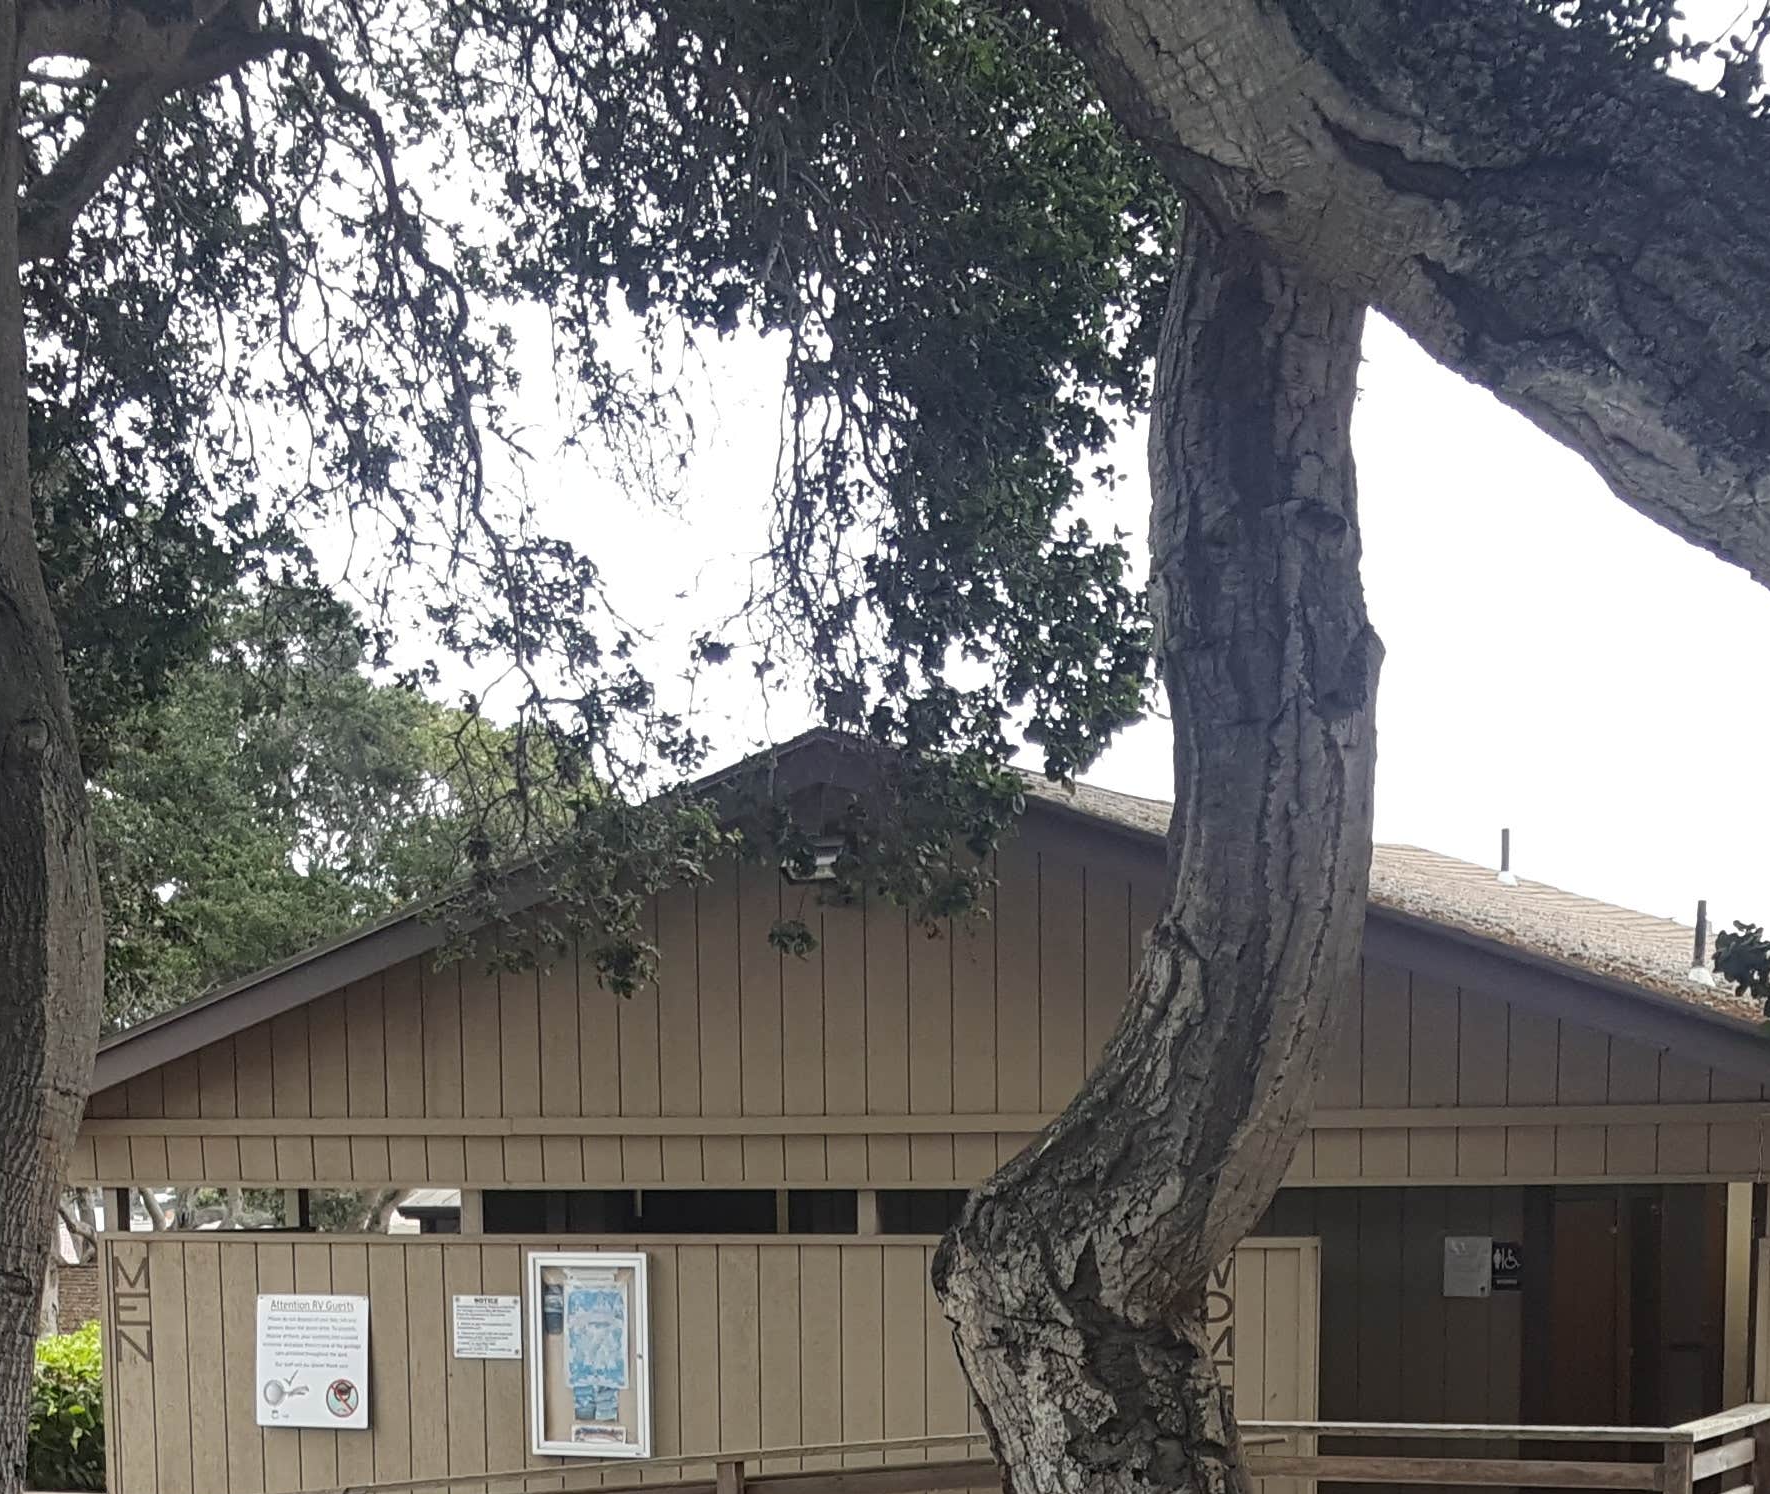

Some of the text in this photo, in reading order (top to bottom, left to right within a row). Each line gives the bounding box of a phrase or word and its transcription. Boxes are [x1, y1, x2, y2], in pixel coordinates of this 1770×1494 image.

[113, 1256, 153, 1362] MEN
[271, 1300, 354, 1312] Attention RV Guests
